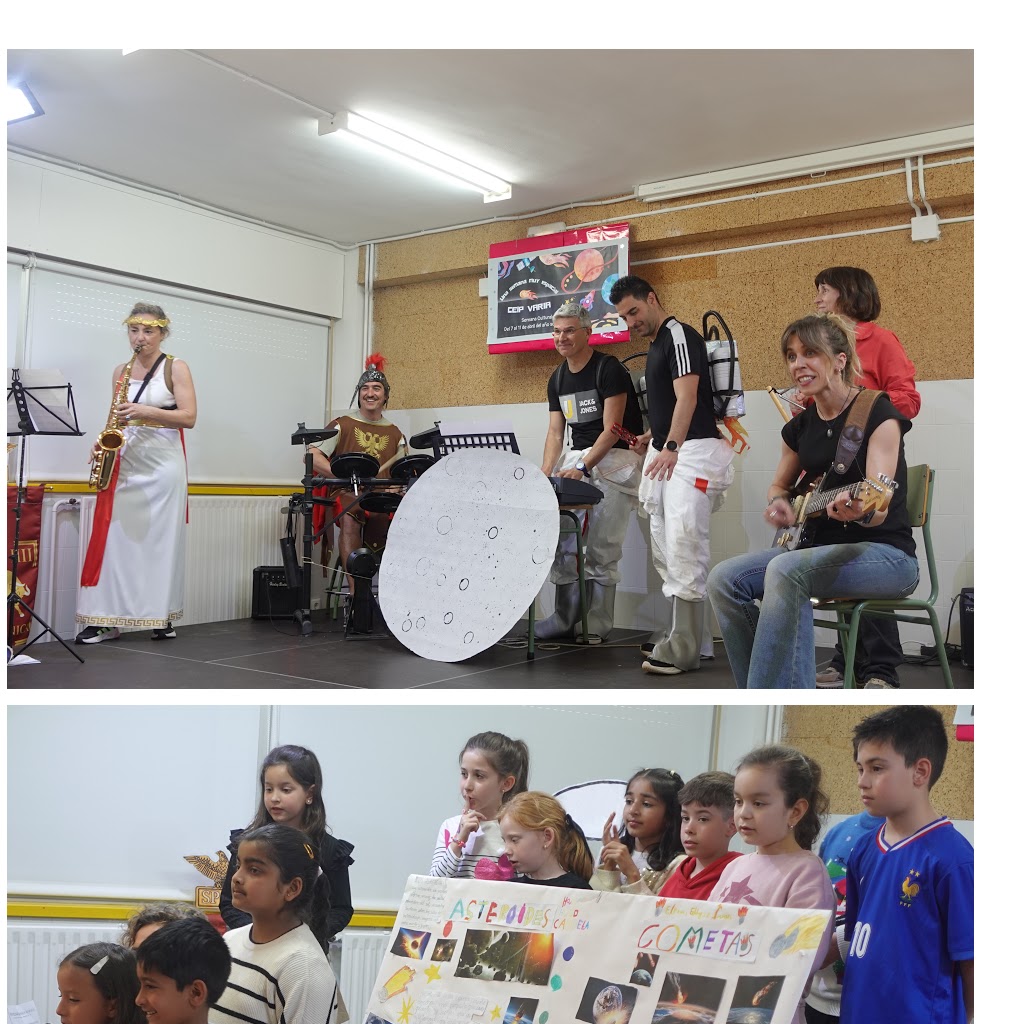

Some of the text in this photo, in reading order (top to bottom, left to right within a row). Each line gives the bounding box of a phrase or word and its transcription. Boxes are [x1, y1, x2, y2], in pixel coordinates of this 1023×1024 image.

[527, 301, 552, 312] VARIA
[580, 405, 598, 415] JONES
[637, 923, 757, 957] COMETAS
[849, 920, 872, 959] 10
